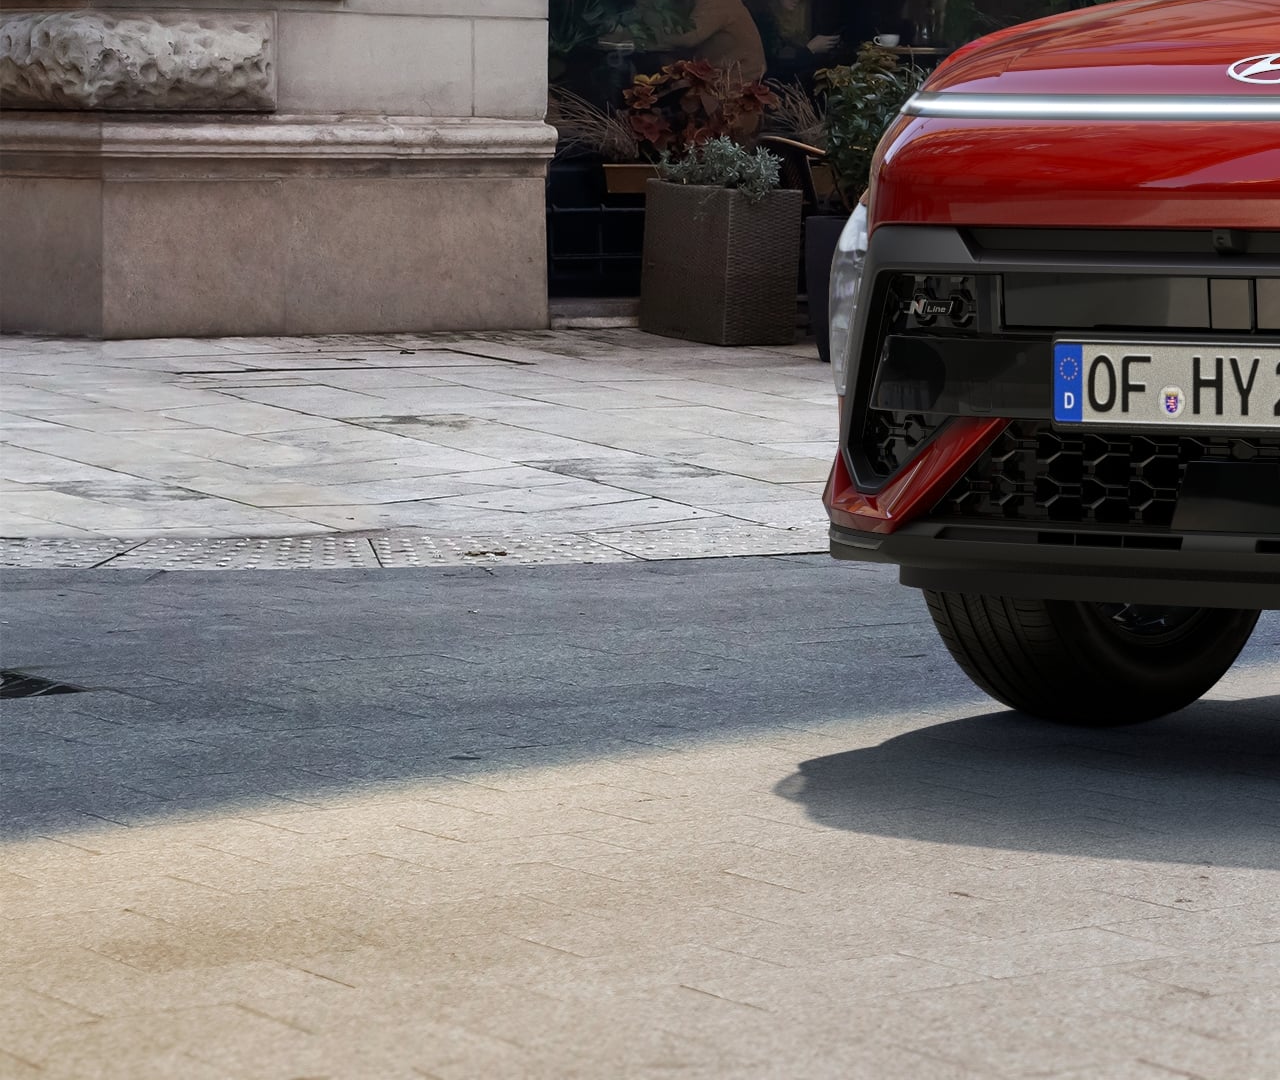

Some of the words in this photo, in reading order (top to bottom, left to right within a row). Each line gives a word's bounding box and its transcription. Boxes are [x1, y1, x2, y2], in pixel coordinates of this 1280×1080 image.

[909, 298, 927, 314] N
[926, 305, 946, 313] Line
[1087, 354, 1152, 413] OF
[1192, 356, 1260, 416] HY
[1063, 392, 1075, 409] D
